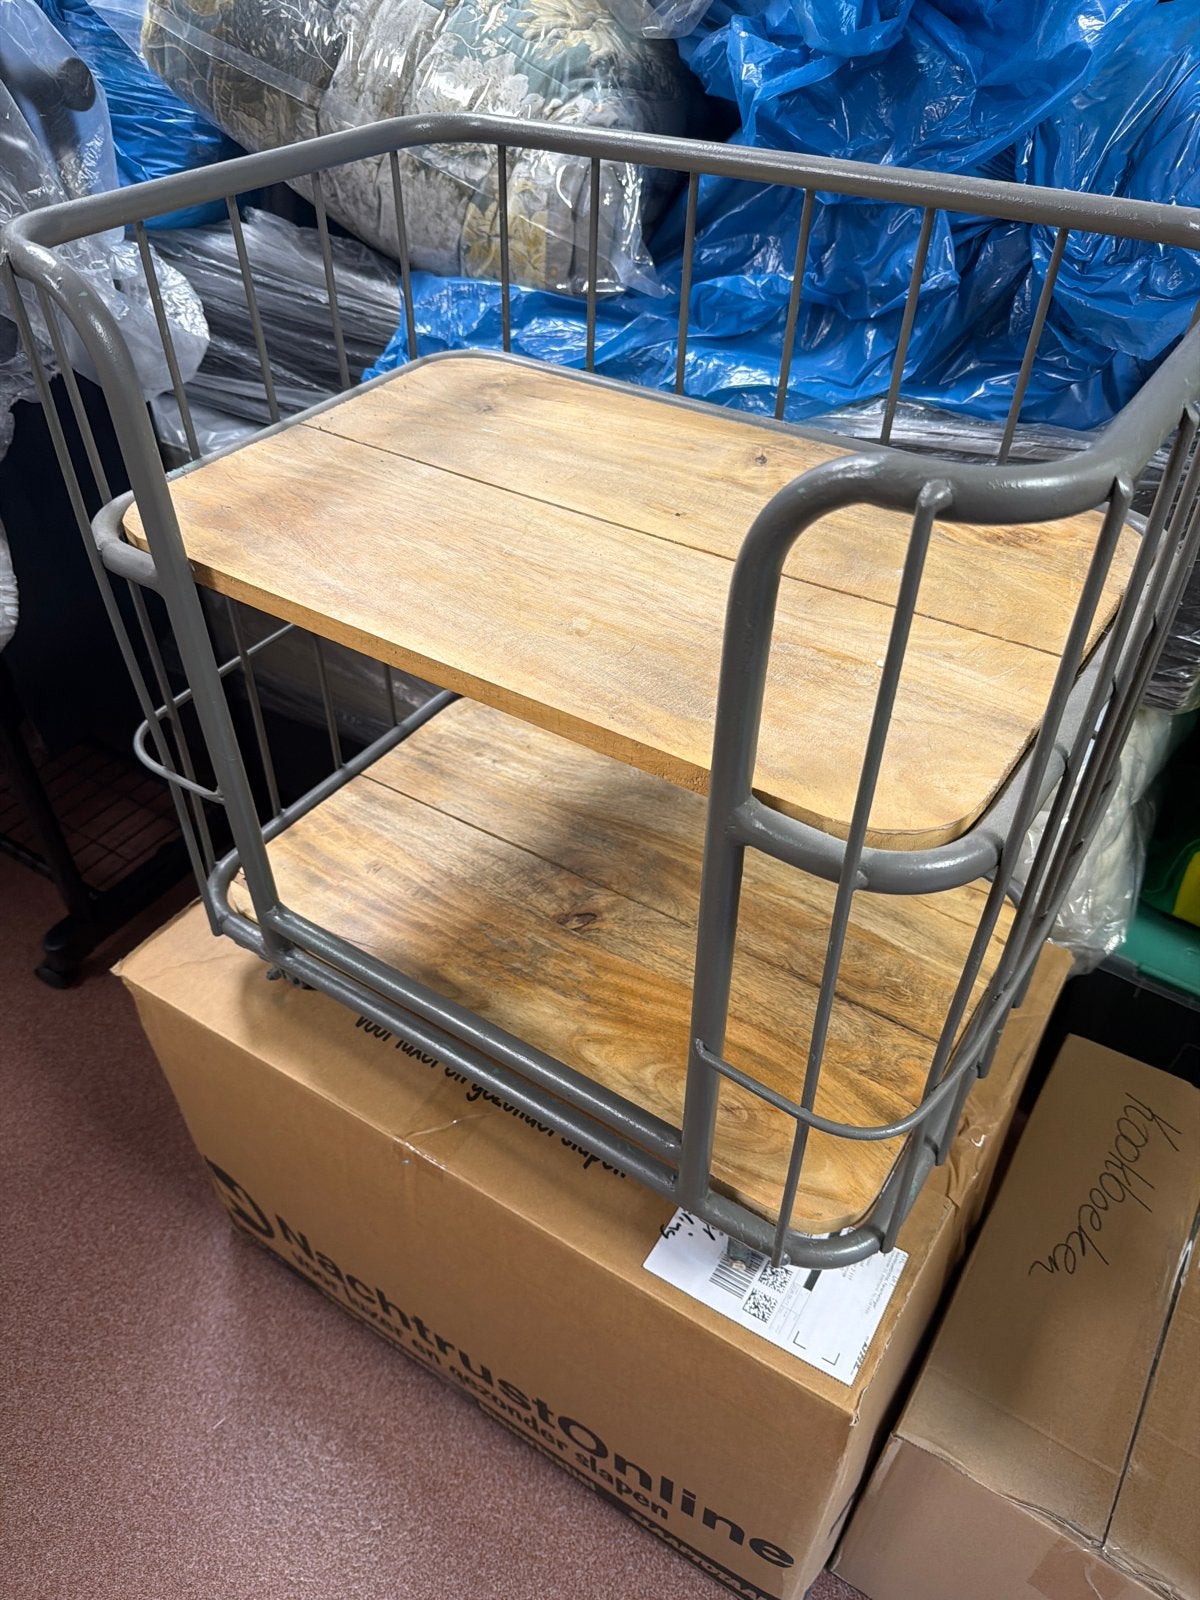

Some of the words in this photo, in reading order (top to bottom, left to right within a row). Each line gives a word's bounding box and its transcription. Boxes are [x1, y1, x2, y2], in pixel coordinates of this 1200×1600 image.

[275, 1214, 795, 1569] NachtrustOnline
[448, 1364, 569, 1452] gezonder
[574, 1451, 669, 1520] slapen
